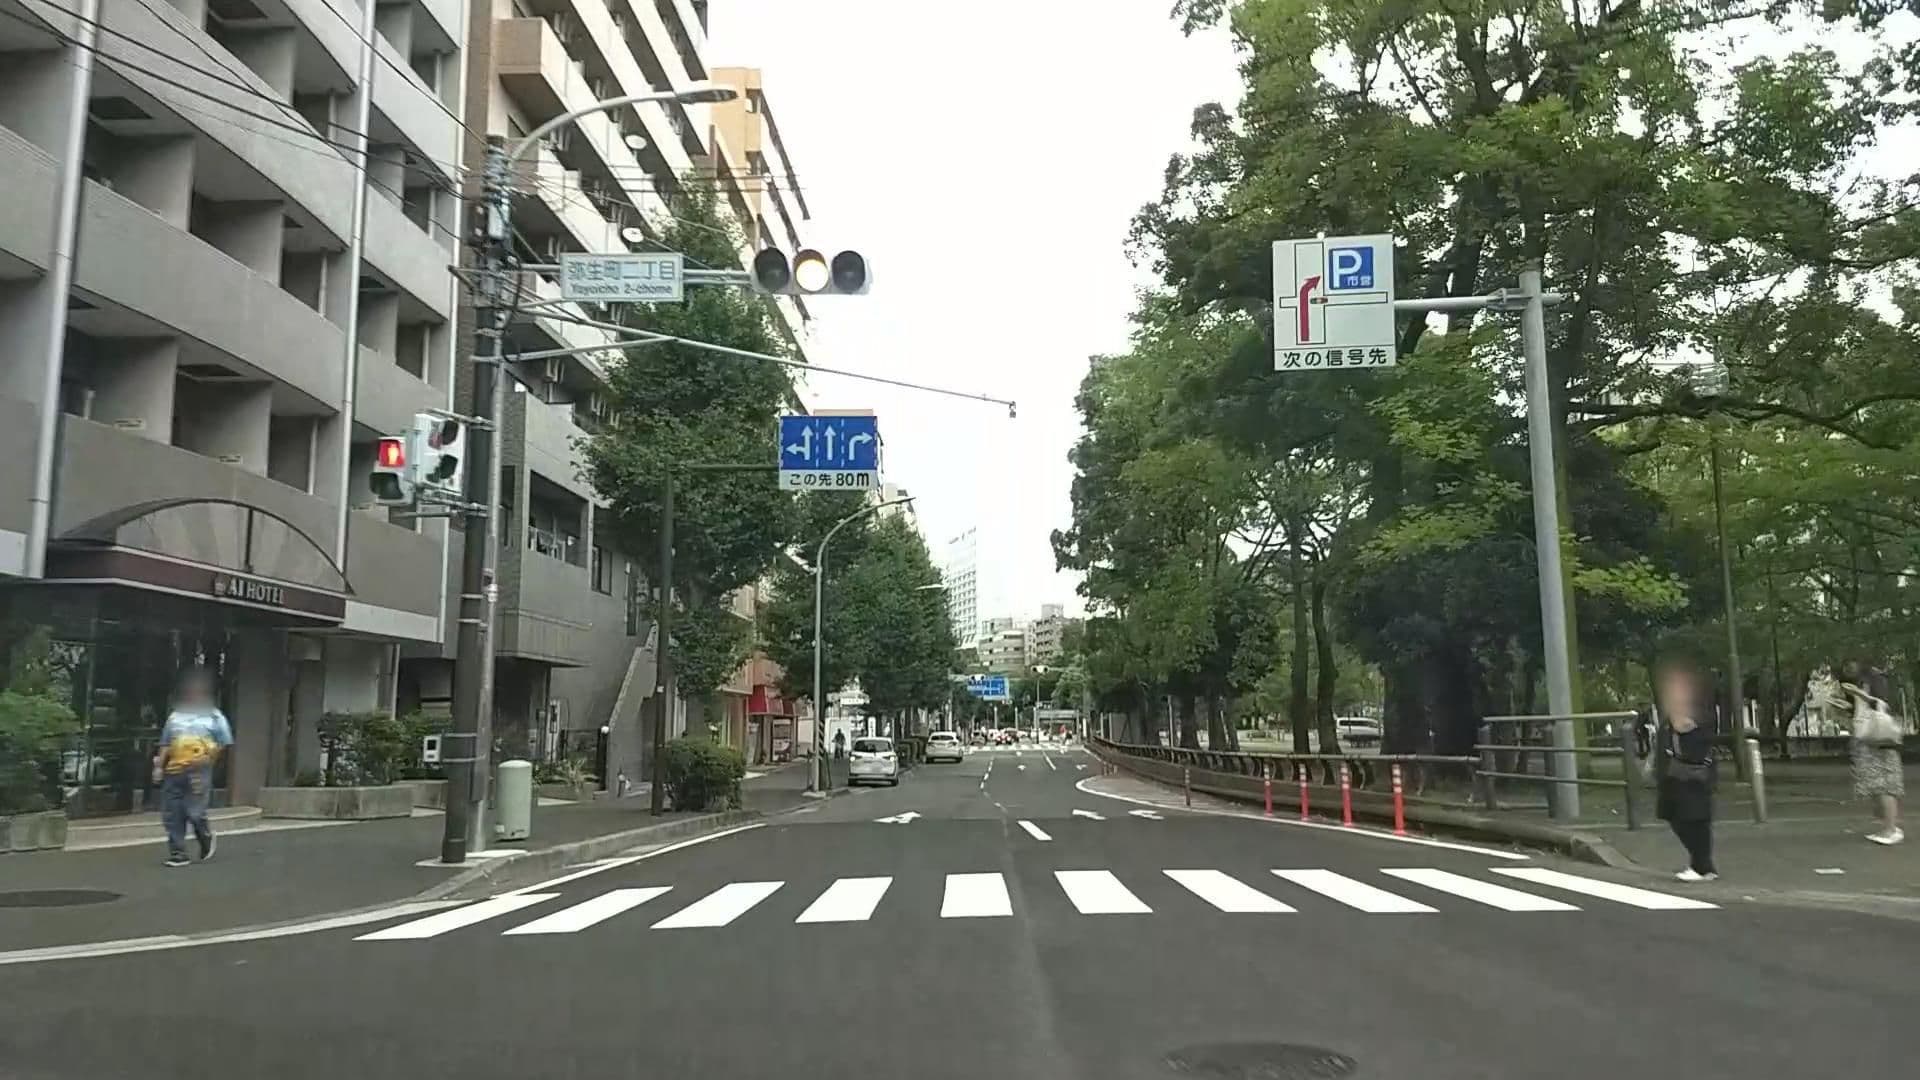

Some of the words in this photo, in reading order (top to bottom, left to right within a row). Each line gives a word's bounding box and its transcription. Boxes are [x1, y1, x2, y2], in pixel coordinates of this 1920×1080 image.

[1332, 249, 1362, 288] P
[1284, 348, 1387, 368] 次の信号先
[246, 581, 284, 604] HOTEL
